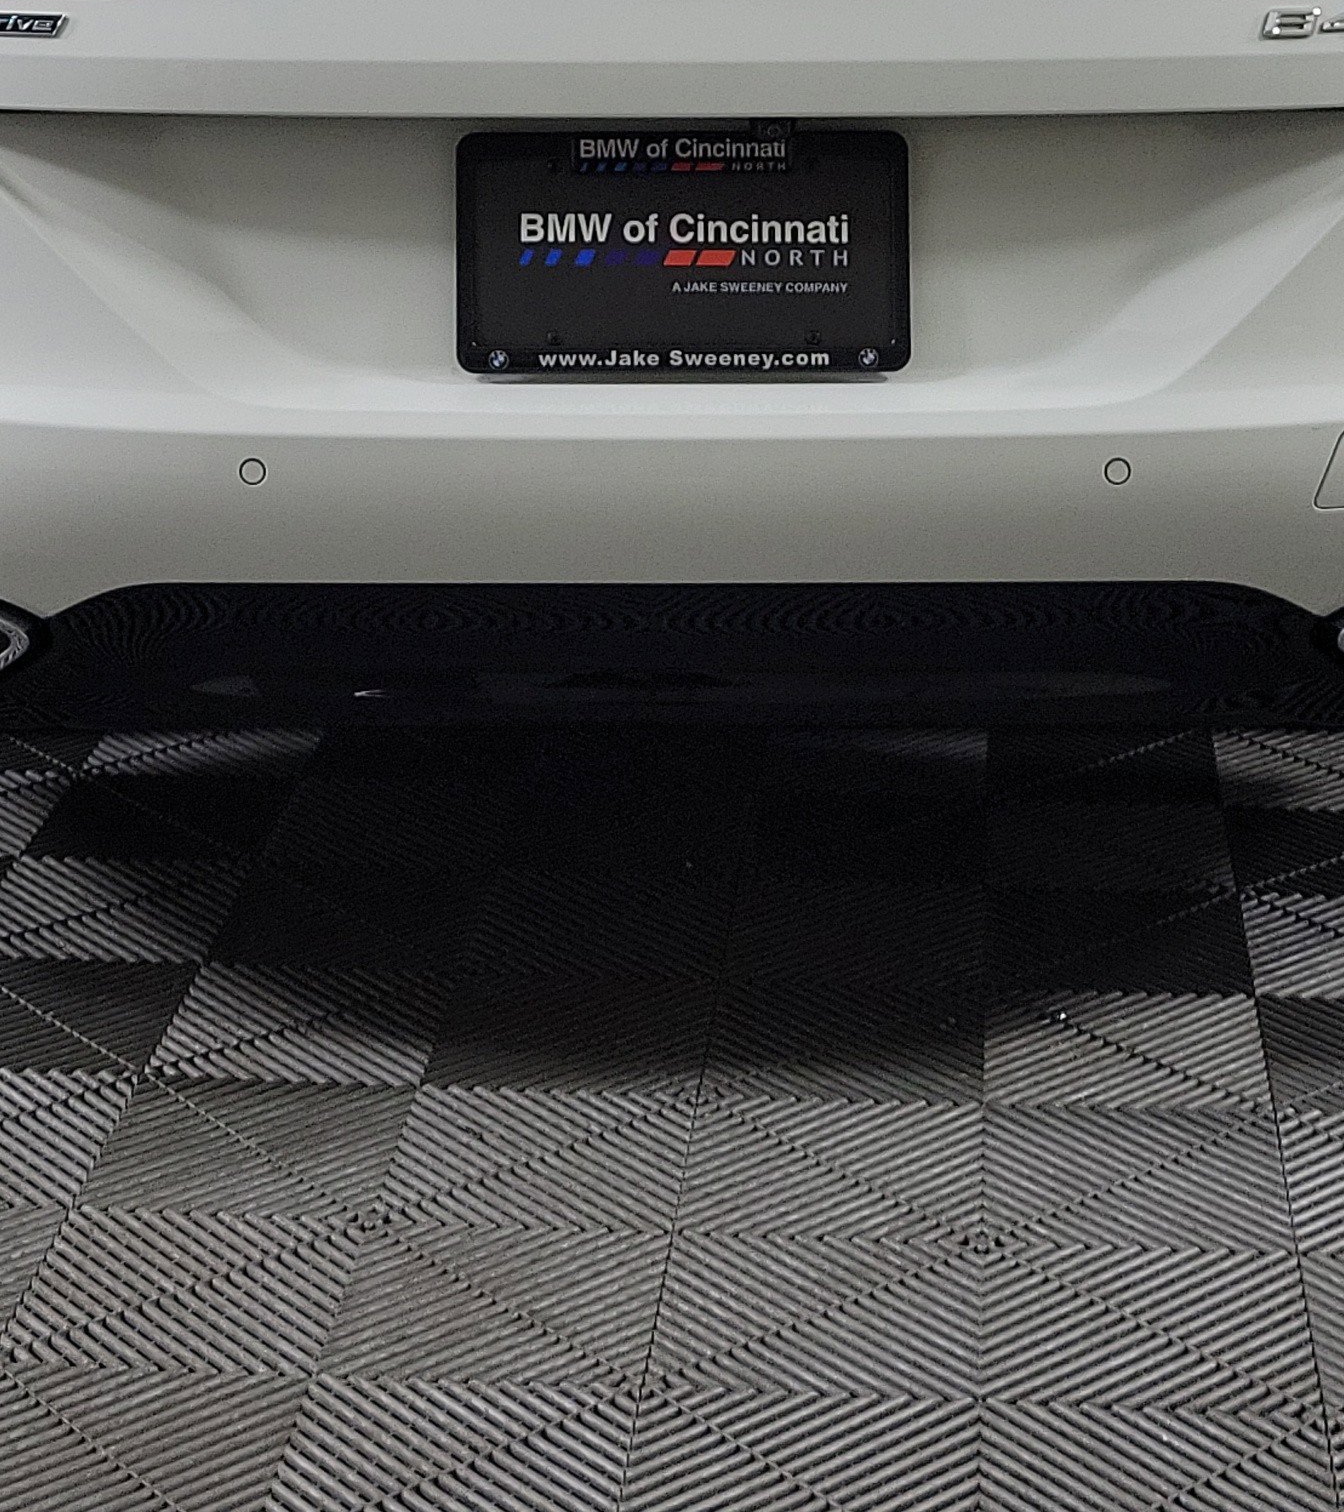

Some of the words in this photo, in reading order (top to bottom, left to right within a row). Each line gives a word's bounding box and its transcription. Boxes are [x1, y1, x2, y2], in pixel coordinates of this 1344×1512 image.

[579, 139, 639, 158] BMW
[646, 139, 669, 158] of
[675, 138, 786, 158] Cincinnati
[731, 162, 786, 171] NORTH
[520, 213, 611, 243] BMW
[623, 213, 659, 243] of
[669, 213, 849, 244] Cincinnati
[741, 249, 848, 266] NORTH
[672, 282, 682, 292] A
[684, 282, 718, 292] JAKE
[720, 282, 783, 293] SWEENEY
[785, 282, 848, 293] COMPANY
[539, 350, 660, 366] www.Jake
[669, 350, 830, 370] Sweeney.com
